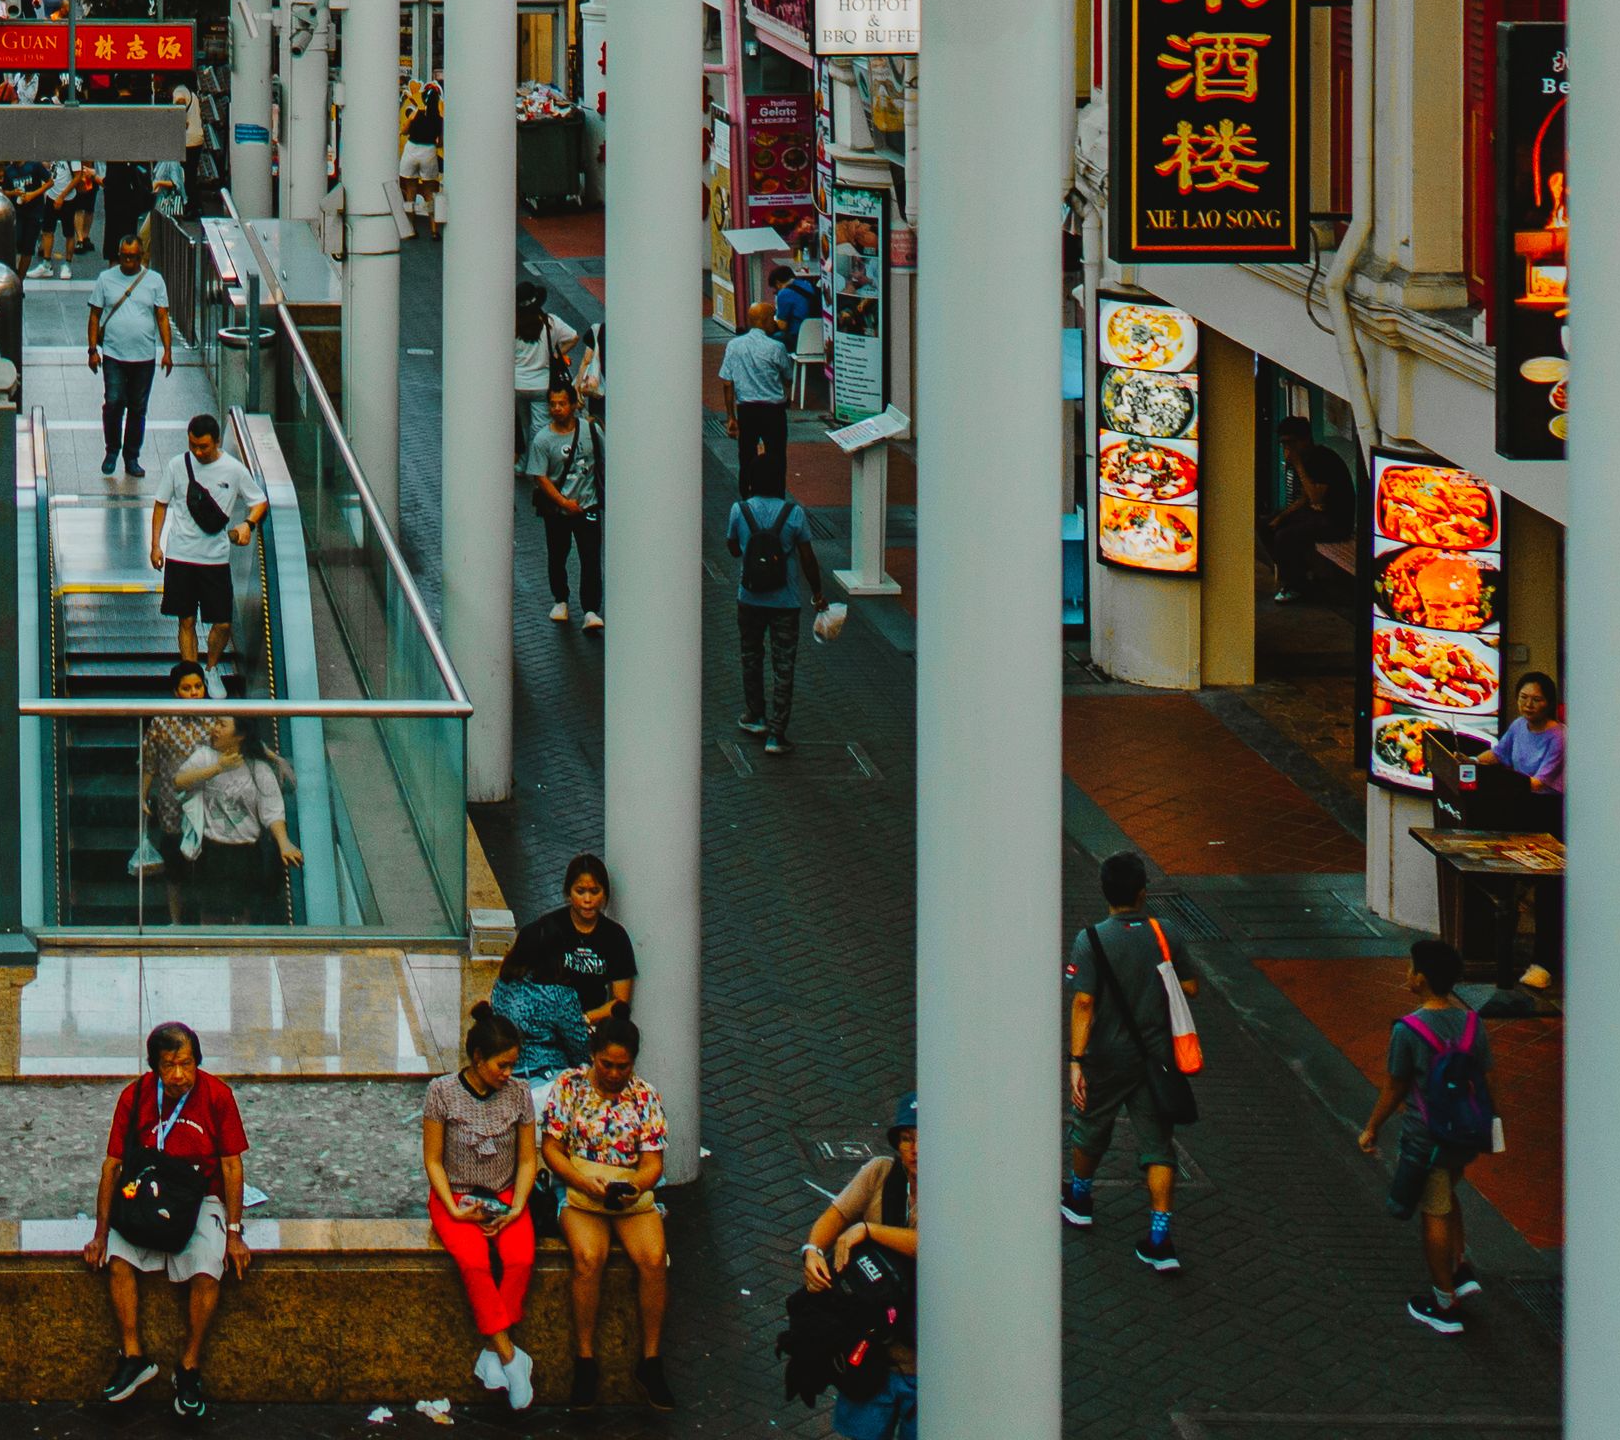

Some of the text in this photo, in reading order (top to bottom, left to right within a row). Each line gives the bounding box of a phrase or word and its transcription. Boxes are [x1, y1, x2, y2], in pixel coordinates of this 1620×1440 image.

[867, 14, 880, 27] &
[1, 30, 59, 49] GUAN
[822, 29, 857, 45] BBQ
[94, 33, 183, 61] 林志源
[759, 107, 797, 117] Gelato
[1145, 209, 1282, 229] XIE LAO SONG
